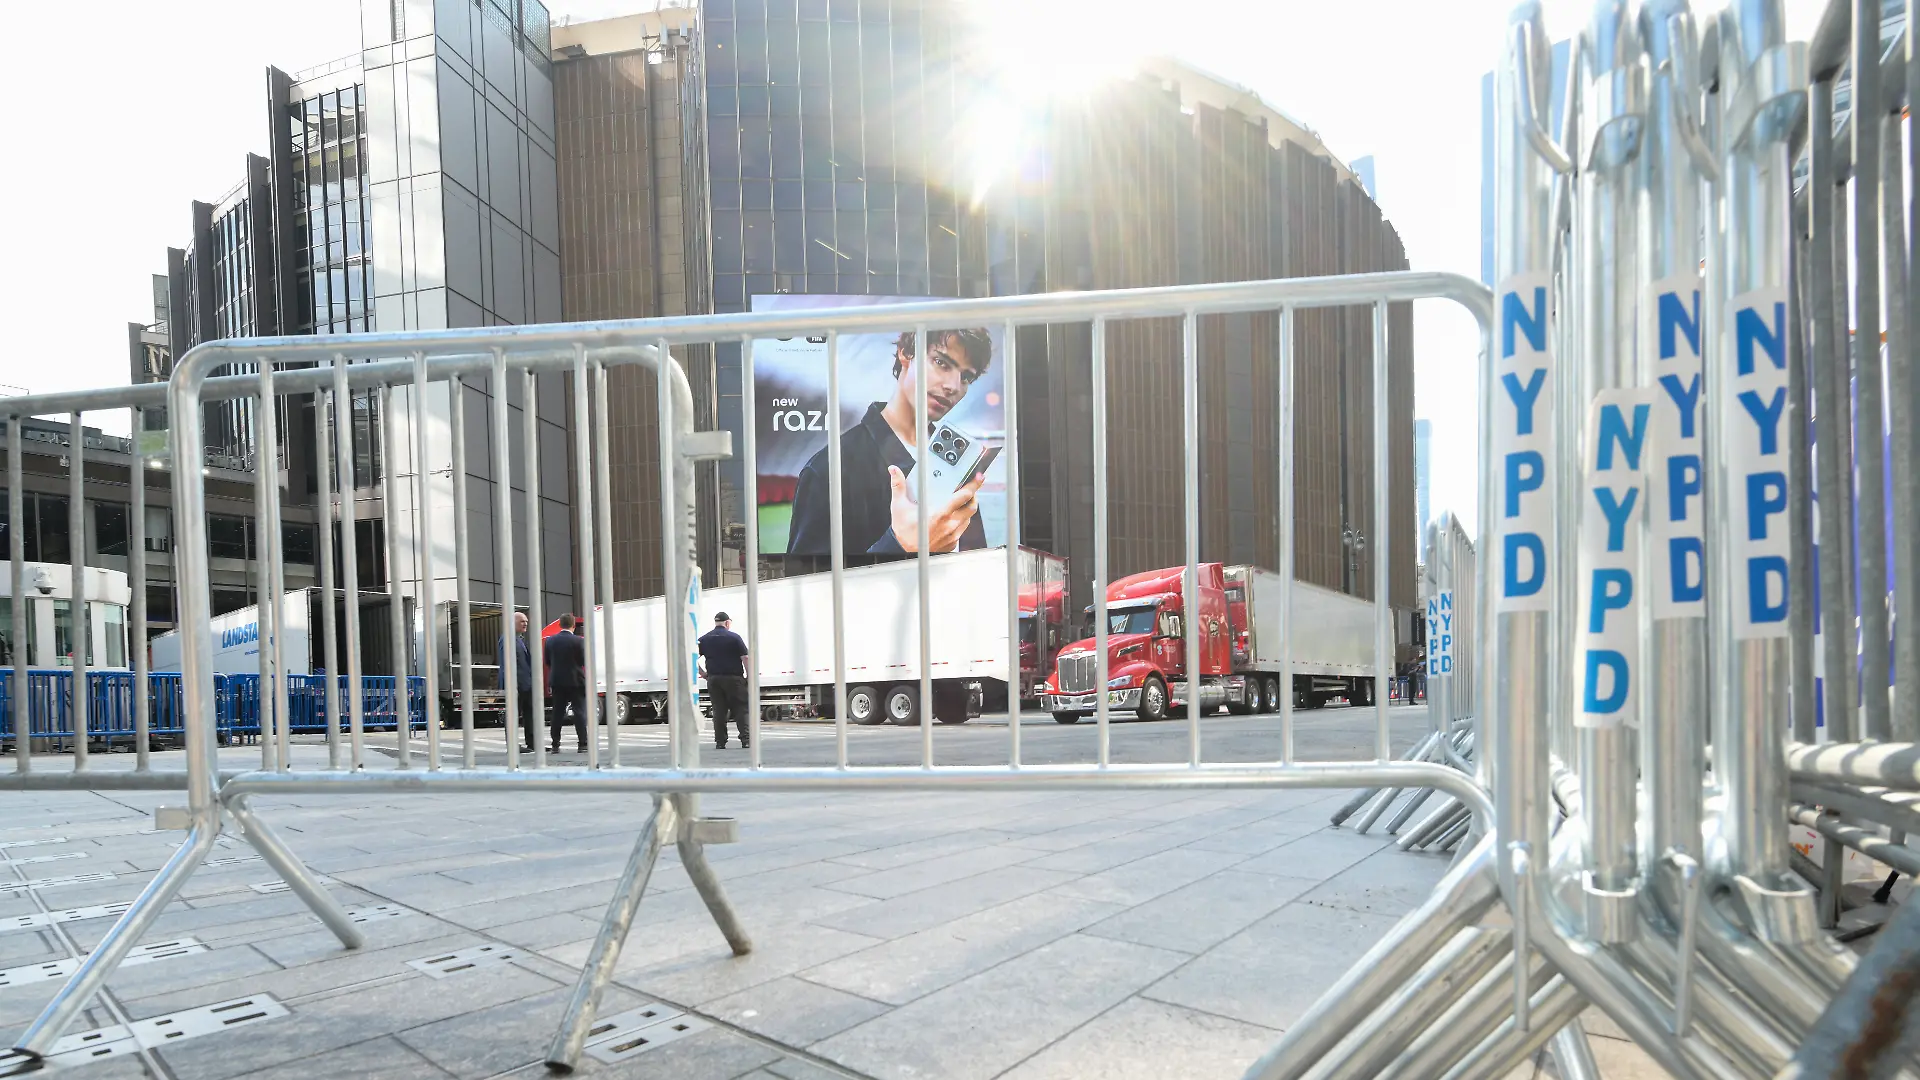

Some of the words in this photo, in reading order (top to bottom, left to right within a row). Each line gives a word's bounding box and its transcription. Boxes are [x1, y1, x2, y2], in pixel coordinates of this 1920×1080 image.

[772, 398, 798, 407] new
[1501, 286, 1547, 598] NYPD
[1658, 289, 1704, 603] NYPD
[1736, 302, 1790, 624] NYPD
[222, 621, 259, 648] LANDSTA
[1441, 593, 1452, 672] NYPD
[1583, 403, 1650, 714] NYPD
